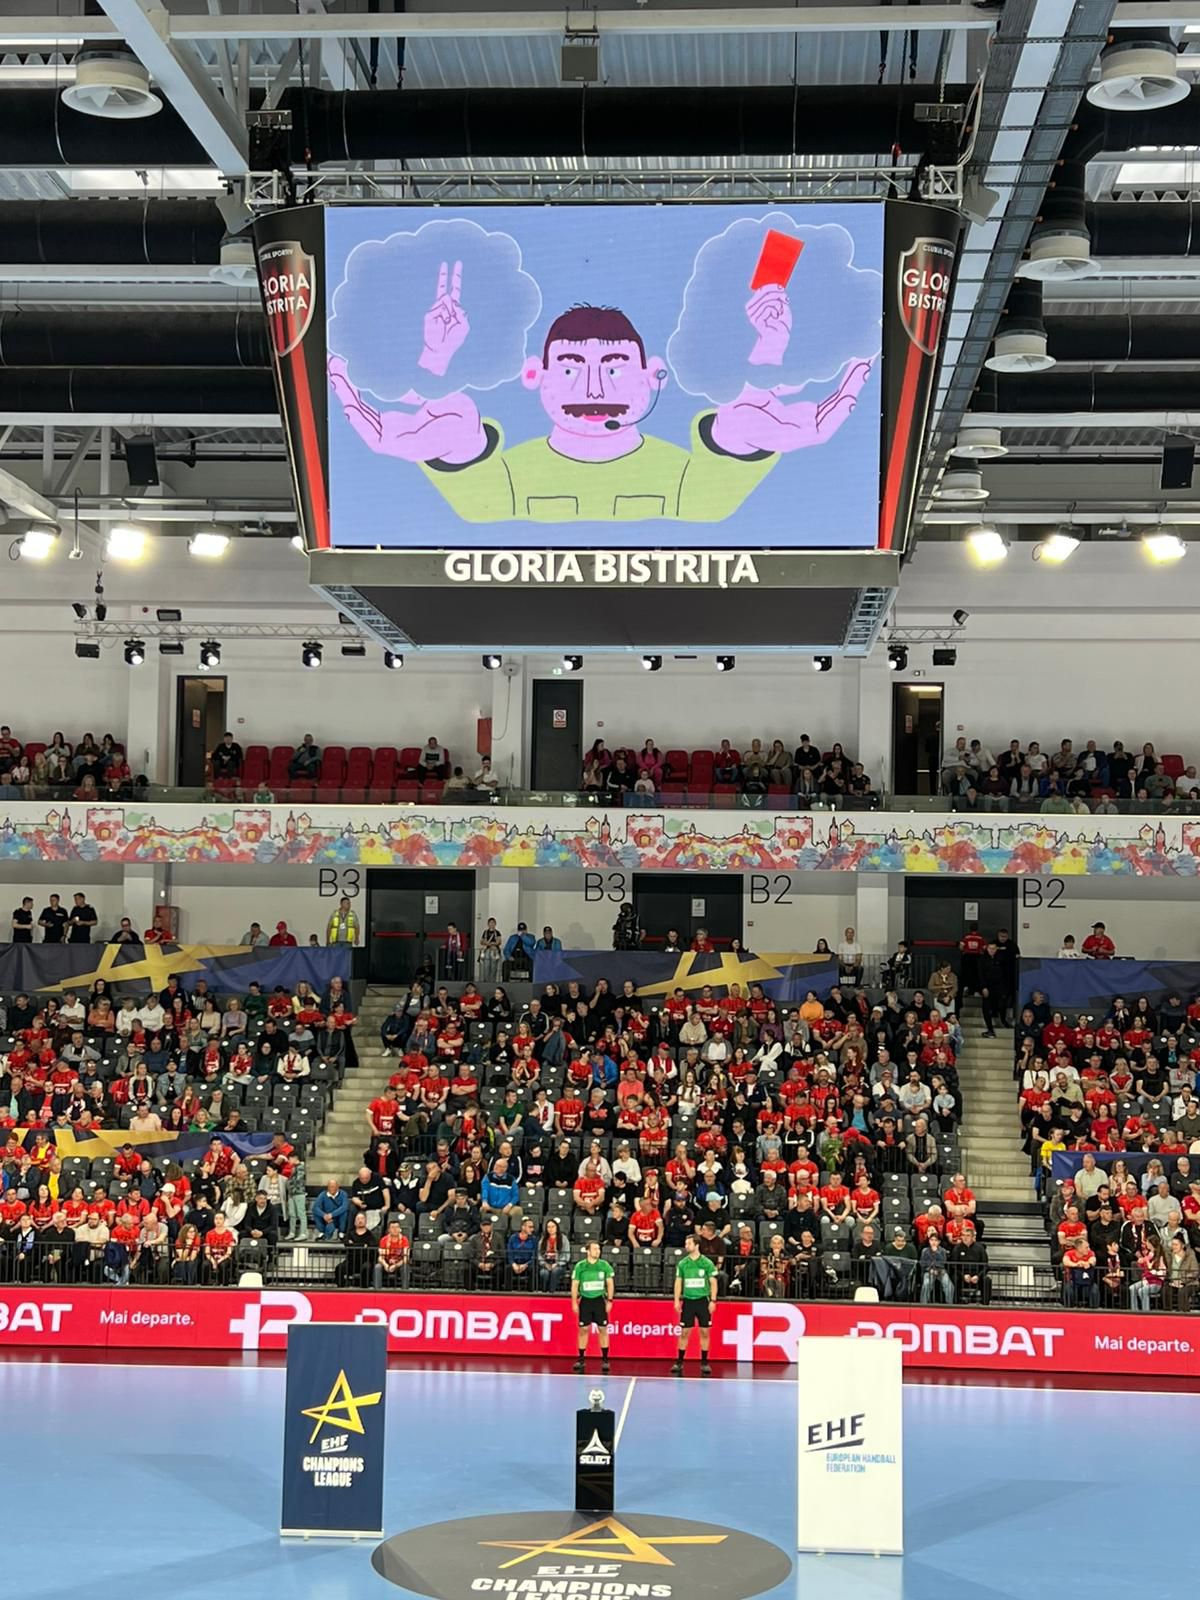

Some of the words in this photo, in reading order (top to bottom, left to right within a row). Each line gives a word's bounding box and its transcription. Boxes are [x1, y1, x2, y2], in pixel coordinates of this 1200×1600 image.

[262, 272, 310, 297] LORIA
[445, 552, 584, 582] GLORIA
[319, 868, 360, 898] B3
[584, 872, 626, 902] B3
[750, 874, 793, 905] B2
[1023, 878, 1066, 908] B2
[100, 1310, 128, 1324] Mai
[131, 1311, 195, 1328] departe.
[1094, 1335, 1123, 1350] Mai
[1127, 1336, 1194, 1354] departe.
[807, 1413, 865, 1446] EHF
[321, 1434, 348, 1451] EHF
[303, 1456, 364, 1472] CHAMPIONS
[579, 1455, 611, 1465] SELECT
[826, 1452, 861, 1463] EUROPEAN
[862, 1454, 896, 1464] HANDBALL
[826, 1463, 866, 1473] FEDERATION
[314, 1471, 352, 1487] LEAGUE
[536, 1564, 622, 1575] EHF
[470, 1578, 672, 1597] CHAMPIONS
